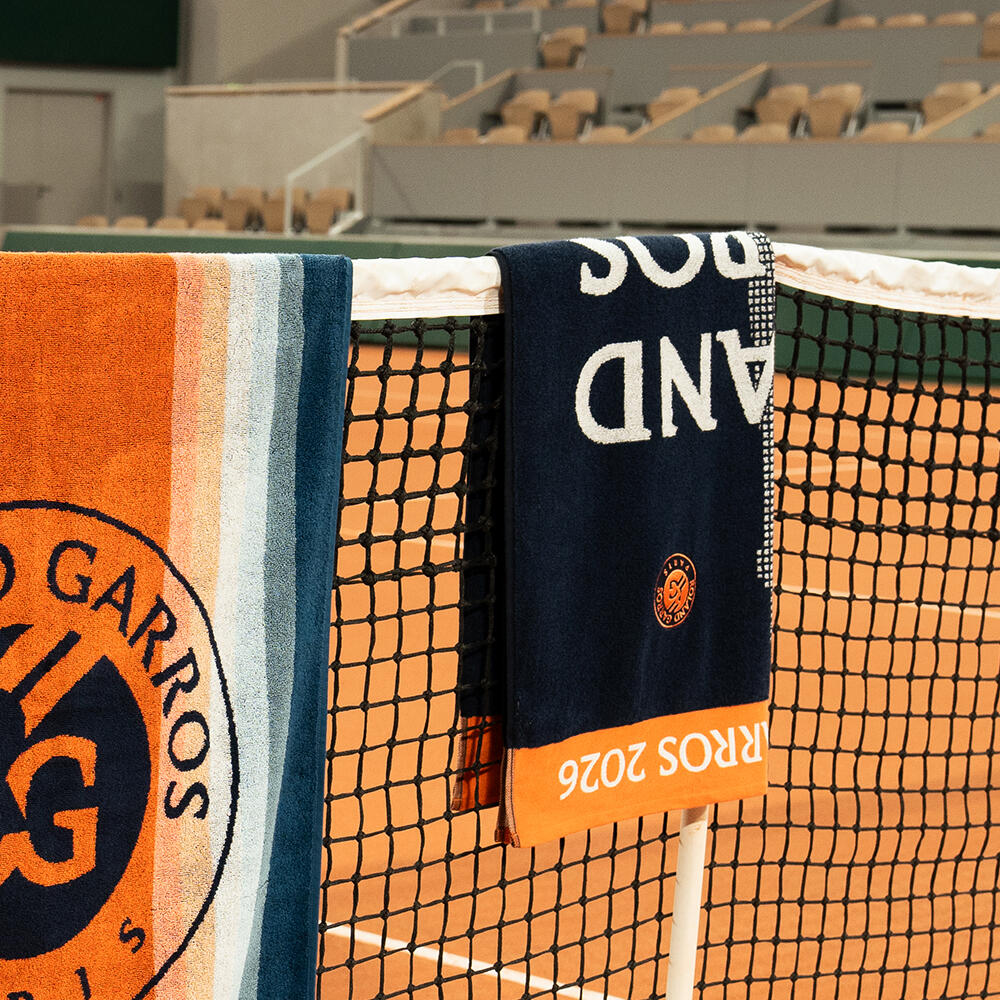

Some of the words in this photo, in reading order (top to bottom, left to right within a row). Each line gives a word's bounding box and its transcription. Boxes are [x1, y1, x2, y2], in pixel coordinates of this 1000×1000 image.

[46, 539, 211, 822] GARROS
[558, 742, 647, 800] 2026
[659, 721, 769, 776] RROS
